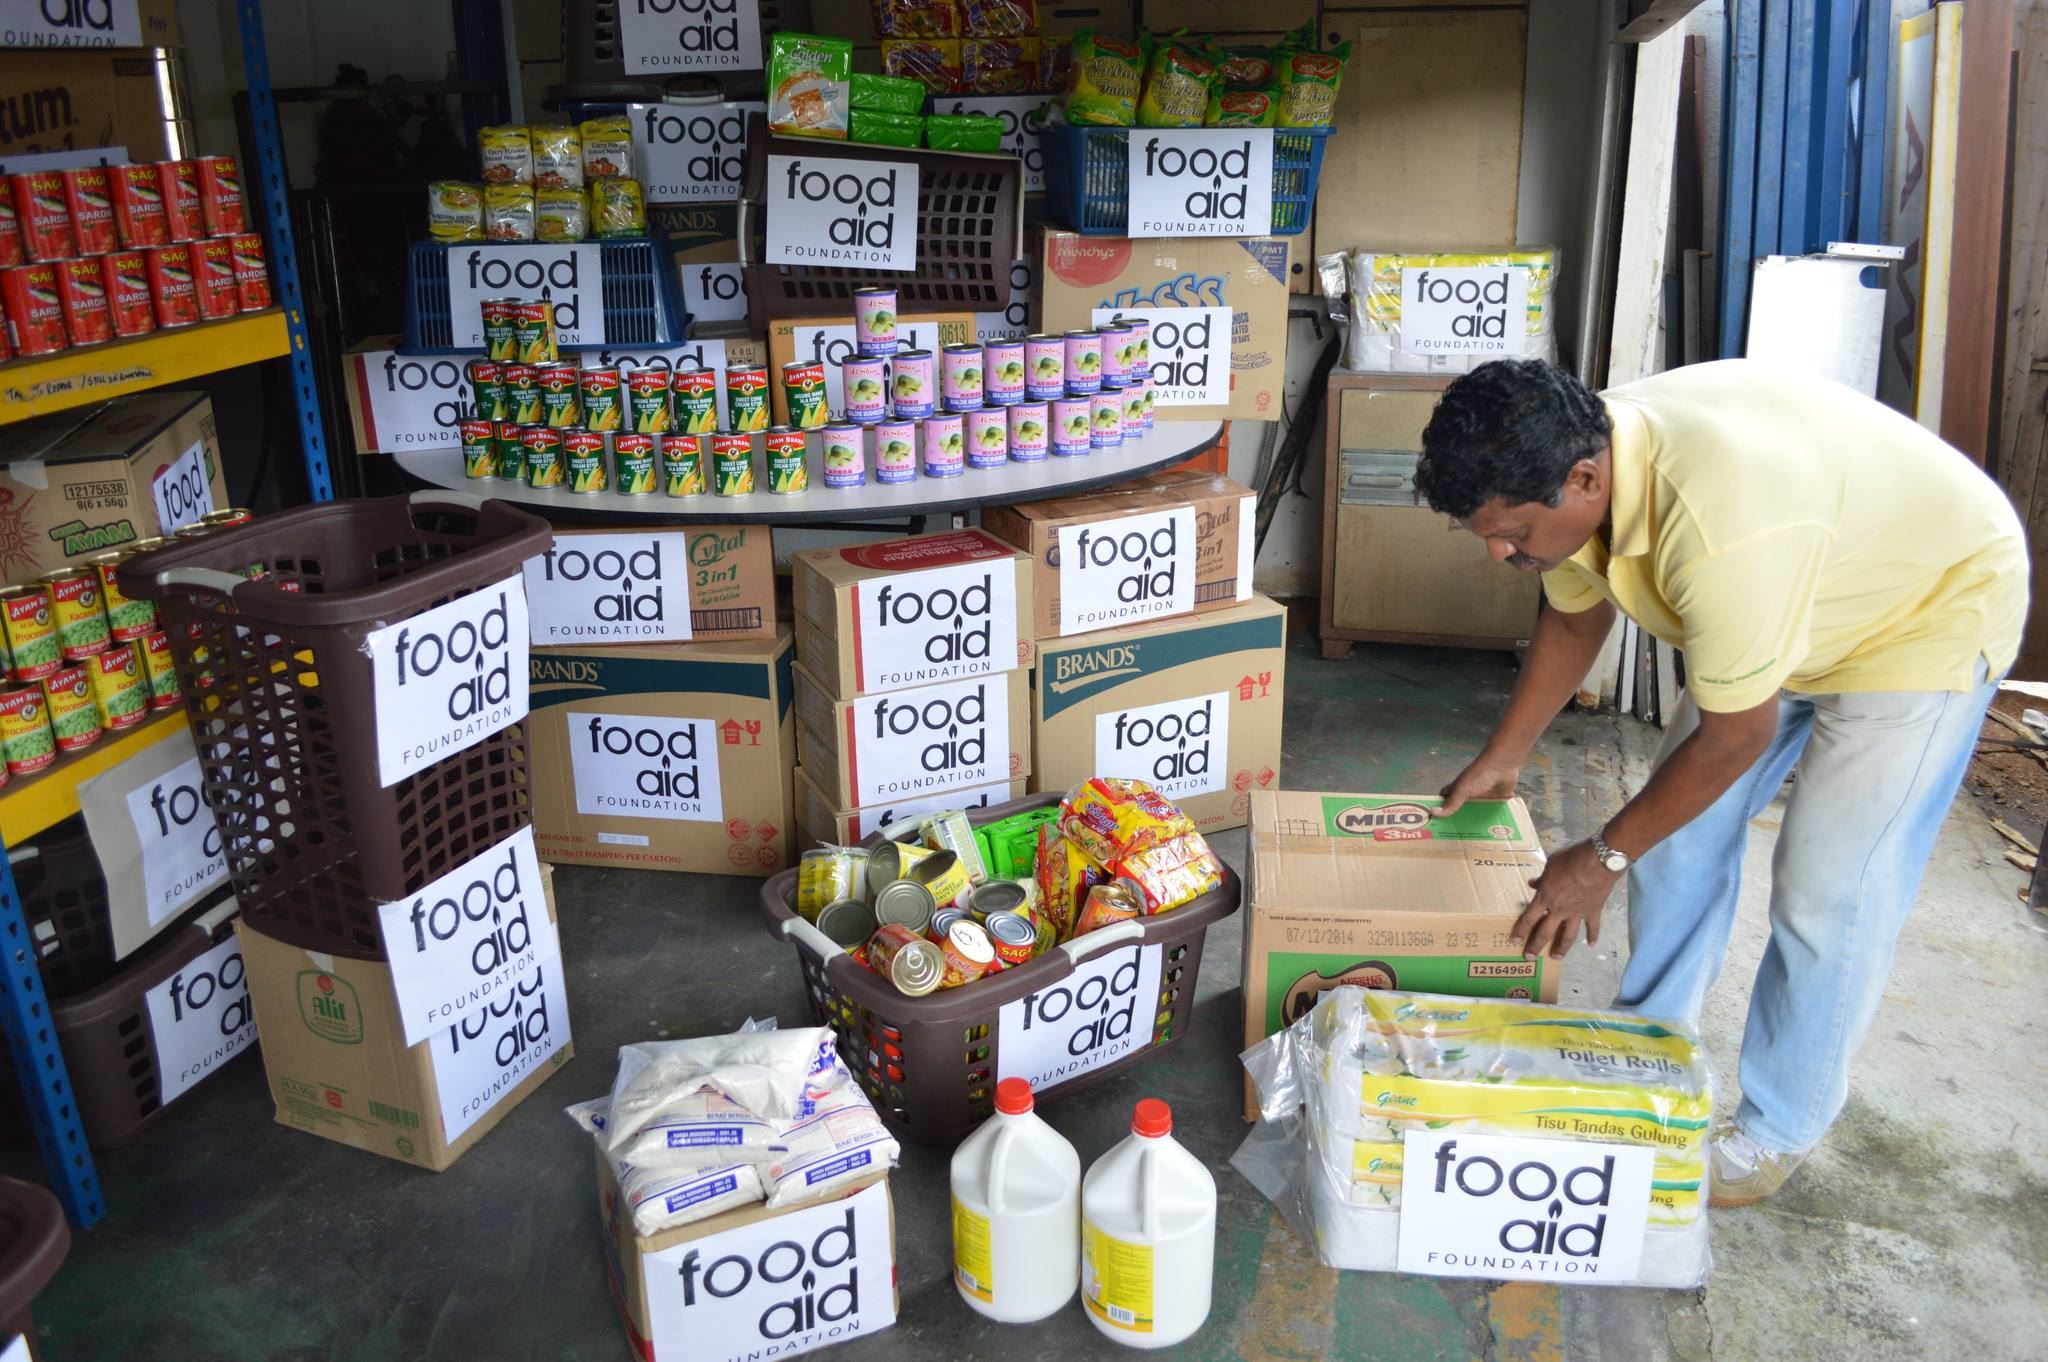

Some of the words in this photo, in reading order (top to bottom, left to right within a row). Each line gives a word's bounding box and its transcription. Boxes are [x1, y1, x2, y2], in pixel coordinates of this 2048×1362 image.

[3, 29, 116, 47] OUNDATION
[680, 17, 739, 51] aid
[641, 54, 740, 66] FOUNDATION
[645, 107, 746, 144] food
[128, 170, 156, 182] SAG
[688, 149, 743, 181] aid
[1145, 137, 1251, 180] food
[649, 185, 736, 195] FOUNDATIO
[787, 160, 897, 207] food
[1185, 184, 1248, 220] aid
[234, 238, 263, 250] SAG
[829, 213, 894, 249] aid
[1143, 221, 1245, 233] FOUNDATION
[161, 251, 189, 263] SAG
[467, 250, 578, 289] food
[784, 245, 892, 263] FOUNDATION
[29, 271, 54, 284] SAG
[1417, 271, 1509, 305] food
[977, 329, 1026, 340] OUNDA
[1451, 309, 1507, 339] aid
[1415, 339, 1505, 350] FOUNDATION
[1151, 354, 1209, 387] aid
[1152, 390, 1207, 400] DATION
[395, 432, 460, 443] FOUNDA
[68, 482, 124, 498] 12175538
[163, 452, 204, 527] food
[543, 540, 661, 582] food
[1077, 517, 1176, 569] food
[1117, 561, 1175, 603] aid
[594, 585, 664, 622] aid
[877, 574, 991, 627] food
[1077, 600, 1174, 624] FOUNDATION
[395, 592, 509, 687] food
[550, 626, 665, 636] FOUNDATION
[925, 620, 991, 664] aid
[448, 652, 511, 722] aid
[529, 661, 599, 682] RAND'S
[880, 661, 990, 685] FOUNDATION
[875, 684, 985, 738] food
[1115, 700, 1212, 750] food
[402, 703, 513, 765] FOUNDATION
[589, 717, 698, 761] food
[921, 728, 985, 772] aid
[1153, 740, 1210, 781] aid
[636, 767, 700, 800] aid
[878, 768, 986, 794] FOUNDATION
[1156, 777, 1209, 794] DATION
[597, 795, 701, 813] FOUNDATION
[1345, 814, 1424, 827] MILO
[164, 858, 225, 903] FOUNDA
[410, 846, 521, 952] food
[472, 901, 531, 976] aid
[170, 953, 244, 1023] foo
[428, 950, 536, 1023] FOUNDATION
[1022, 945, 1142, 1031] food
[1473, 965, 1532, 975] 12164966
[495, 992, 550, 1068] aid
[1068, 996, 1137, 1056] aid
[181, 1026, 258, 1083] FOUNDAT
[1029, 1038, 1131, 1088] OUNDATION
[1555, 1047, 1617, 1067] Toilet
[1625, 1055, 1683, 1075] Rolls
[462, 1037, 553, 1118] FOUNDATION
[1376, 1091, 1418, 1107] Giant
[1535, 1115, 1566, 1131] Tisu
[1572, 1119, 1625, 1136] Tandas
[1630, 1125, 1688, 1149] Gulung
[1368, 1158, 1403, 1172] Gian
[1435, 1140, 1615, 1207] food
[1649, 1196, 1674, 1208] ung
[1499, 1214, 1606, 1258] aid
[679, 1207, 856, 1307] food
[1427, 1252, 1599, 1274] FOUNDATION
[759, 1266, 859, 1340] aid
[728, 1319, 860, 1362] NDATION
